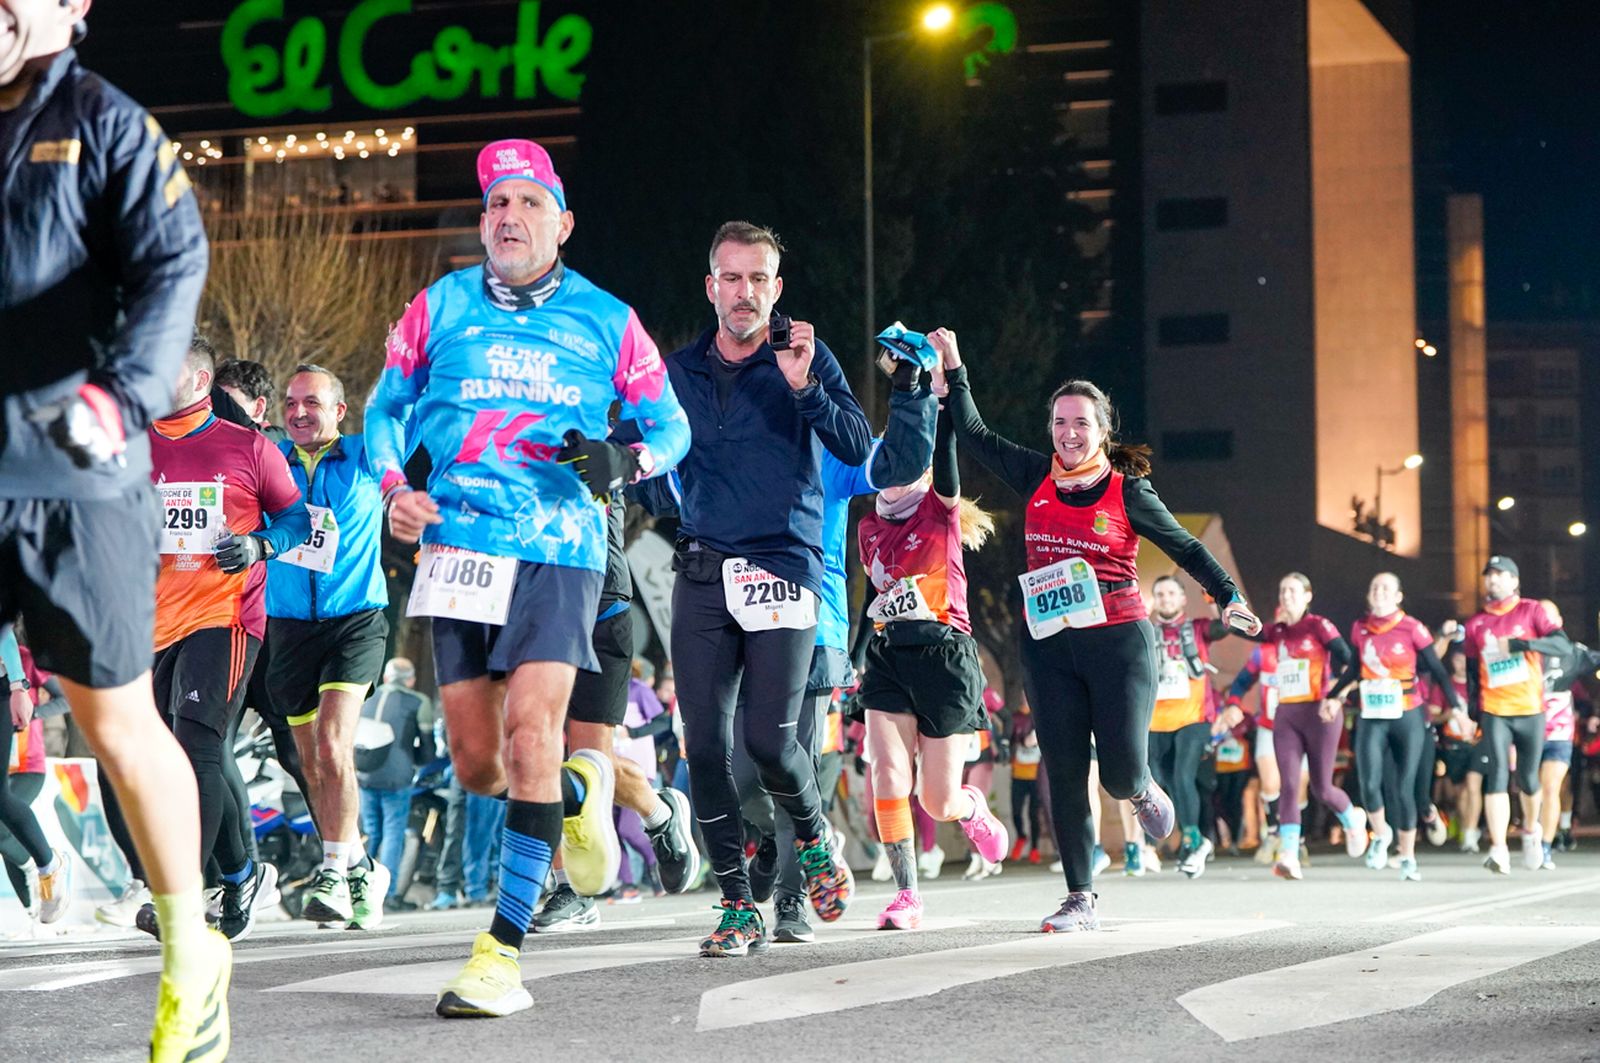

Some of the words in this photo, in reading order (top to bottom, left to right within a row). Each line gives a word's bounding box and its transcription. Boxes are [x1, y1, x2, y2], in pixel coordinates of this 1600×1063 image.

[221, 0, 332, 117] El
[338, 0, 593, 109] Corte
[487, 358, 556, 382] TRAIL
[460, 378, 582, 406] RUNNING
[164, 508, 207, 529] 299
[1066, 539, 1109, 552] RUNNING
[734, 574, 752, 584] SAN
[743, 581, 802, 607] 2209
[1036, 583, 1086, 614] 9298
